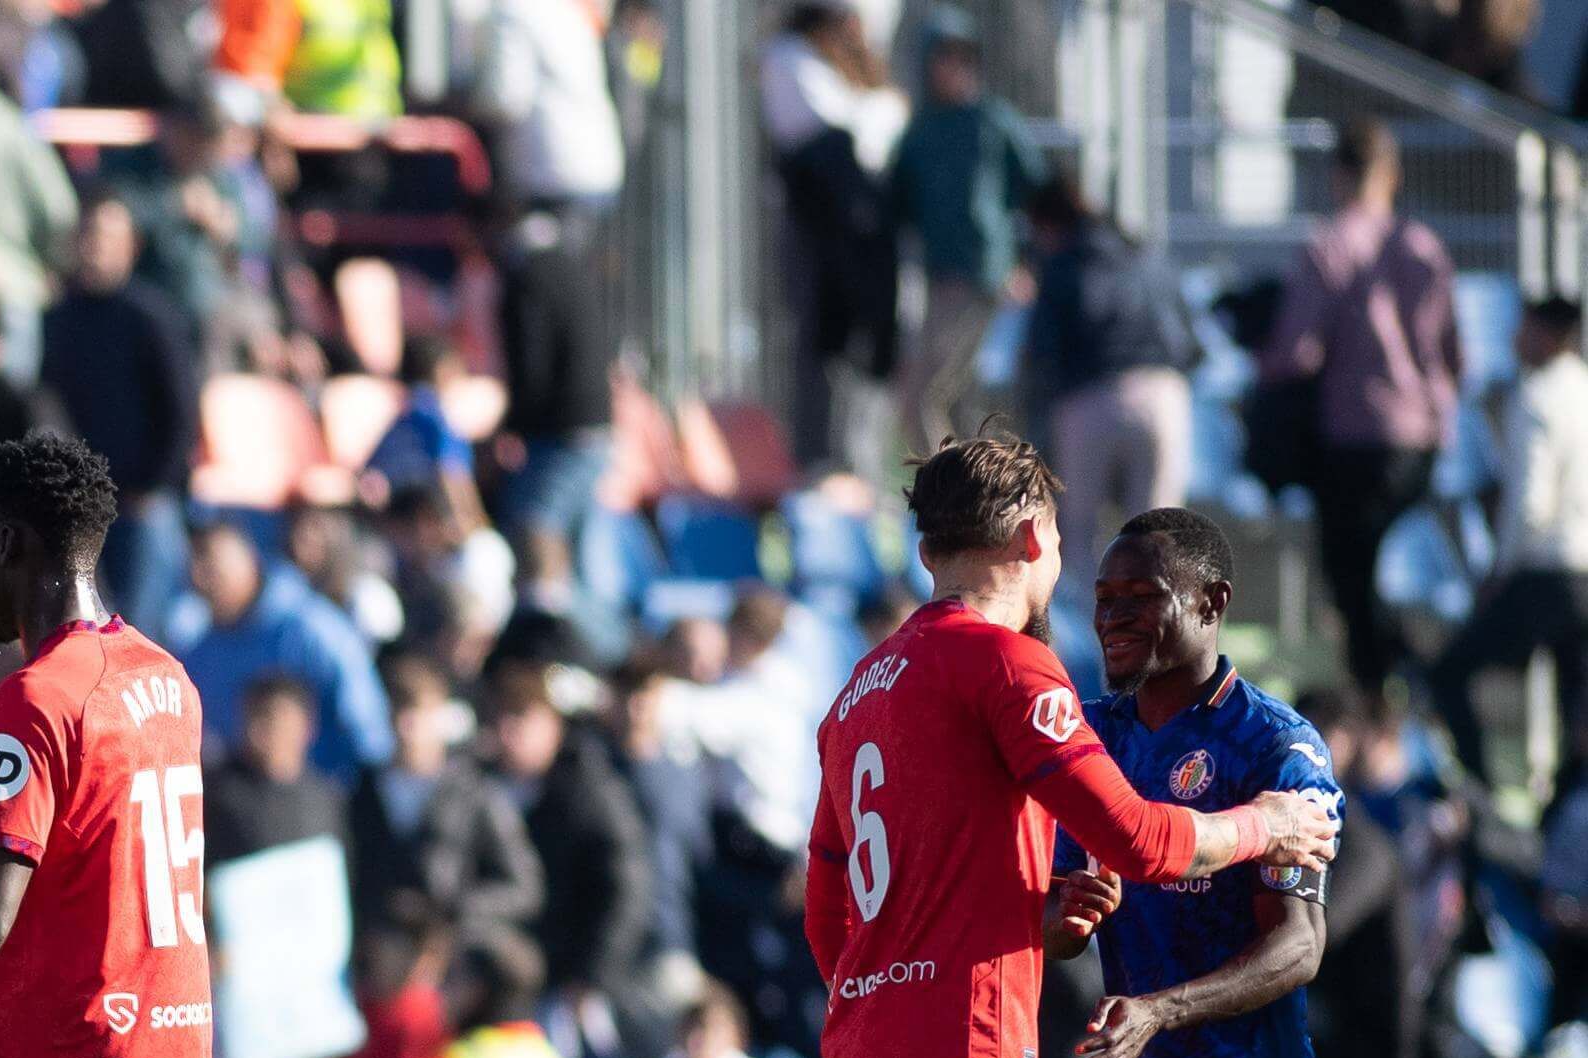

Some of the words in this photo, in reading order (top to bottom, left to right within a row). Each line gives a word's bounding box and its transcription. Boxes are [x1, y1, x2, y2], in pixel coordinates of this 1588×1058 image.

[837, 654, 909, 722] GUDELJ
[128, 765, 206, 948] 15
[847, 741, 891, 923] 6
